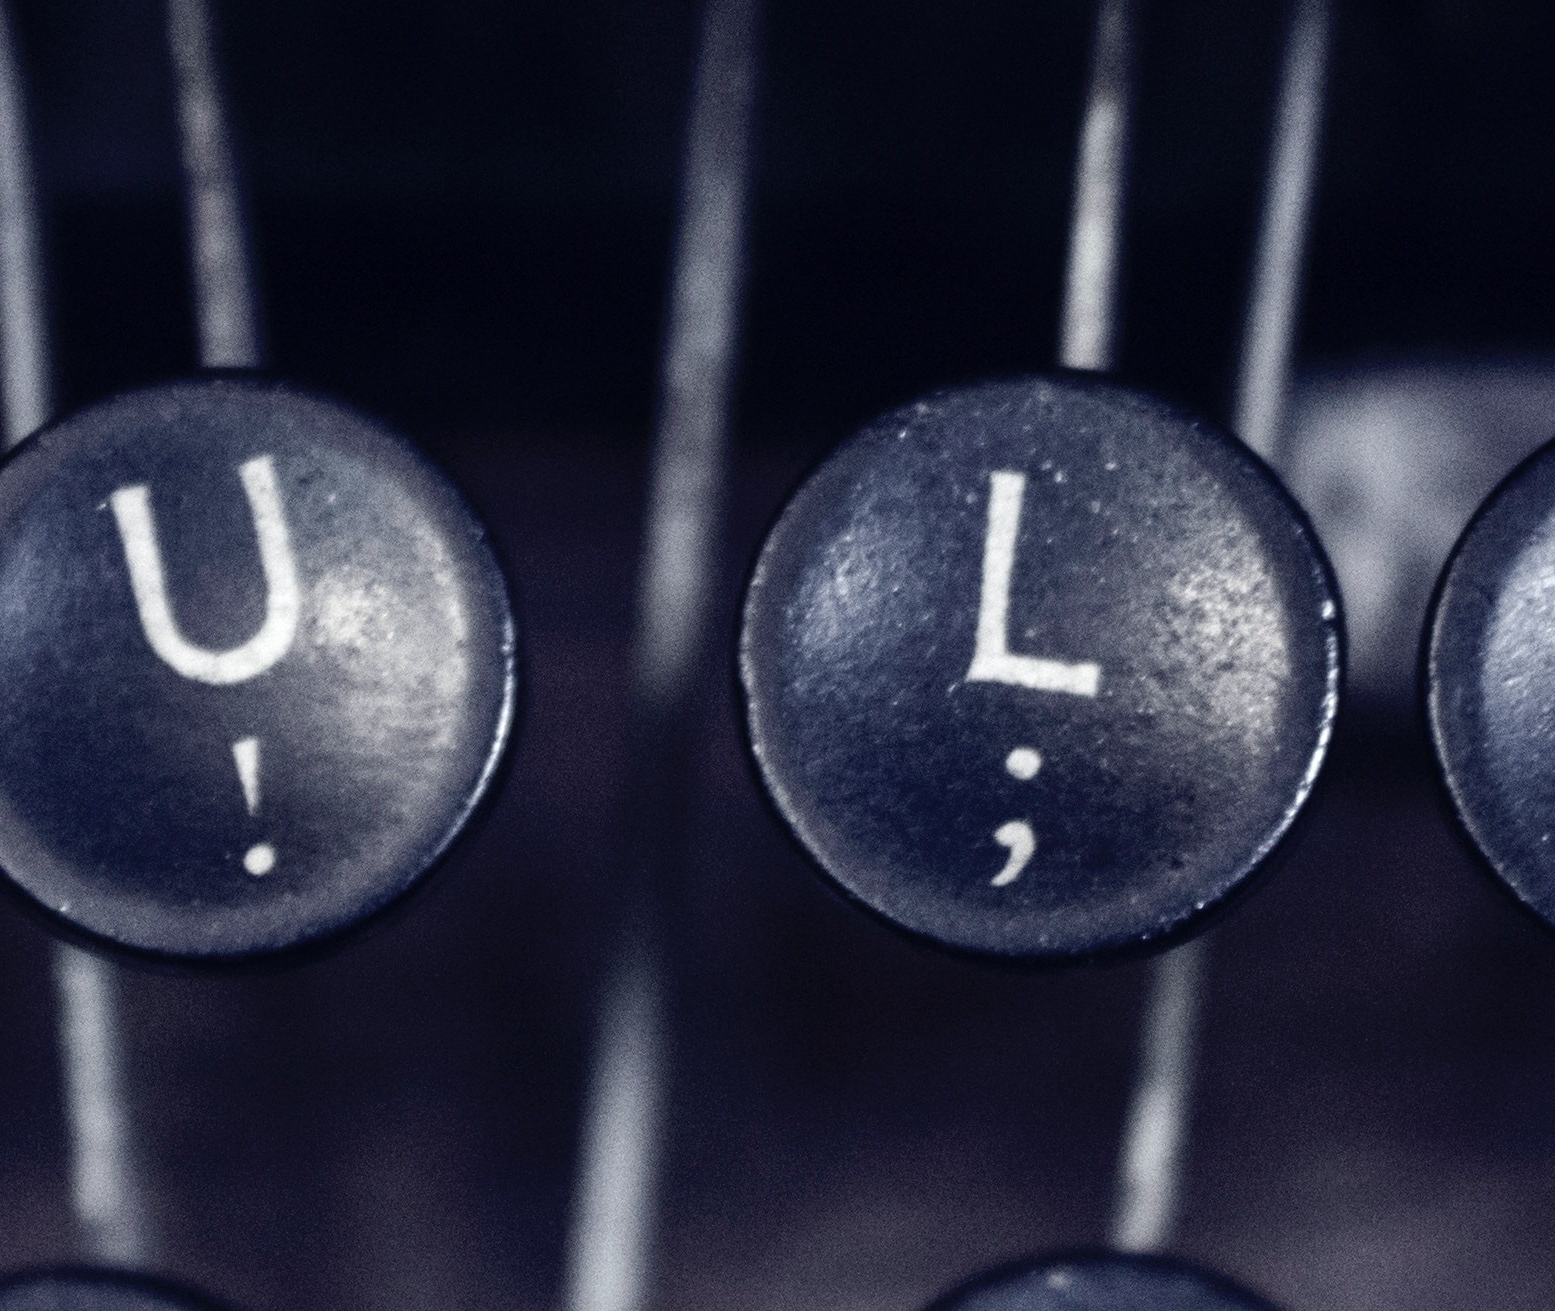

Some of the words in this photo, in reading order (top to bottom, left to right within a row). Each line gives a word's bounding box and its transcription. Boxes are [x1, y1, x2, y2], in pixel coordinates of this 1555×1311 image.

[111, 455, 301, 684] U
[965, 471, 1102, 697] L
[231, 737, 274, 876] !
[992, 745, 1044, 886] ;
